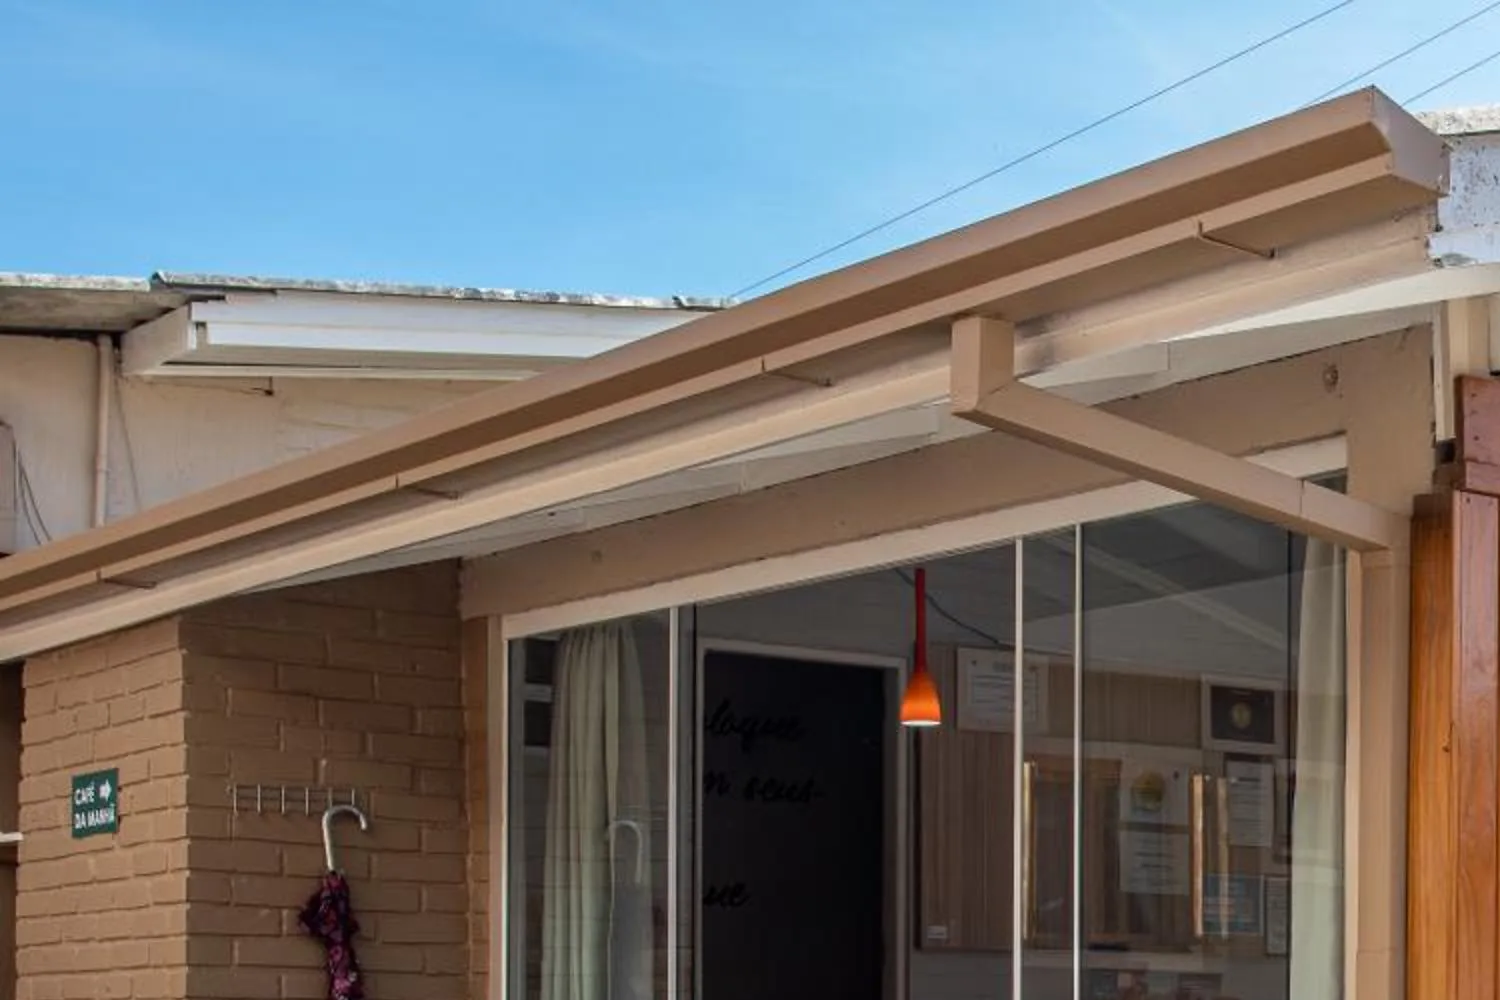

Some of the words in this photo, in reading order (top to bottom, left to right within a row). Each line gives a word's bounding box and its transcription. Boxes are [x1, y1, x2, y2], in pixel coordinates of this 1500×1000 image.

[75, 781, 95, 806] CAFÉ
[75, 811, 87, 829] DA
[88, 803, 115, 828] MANHÃ
